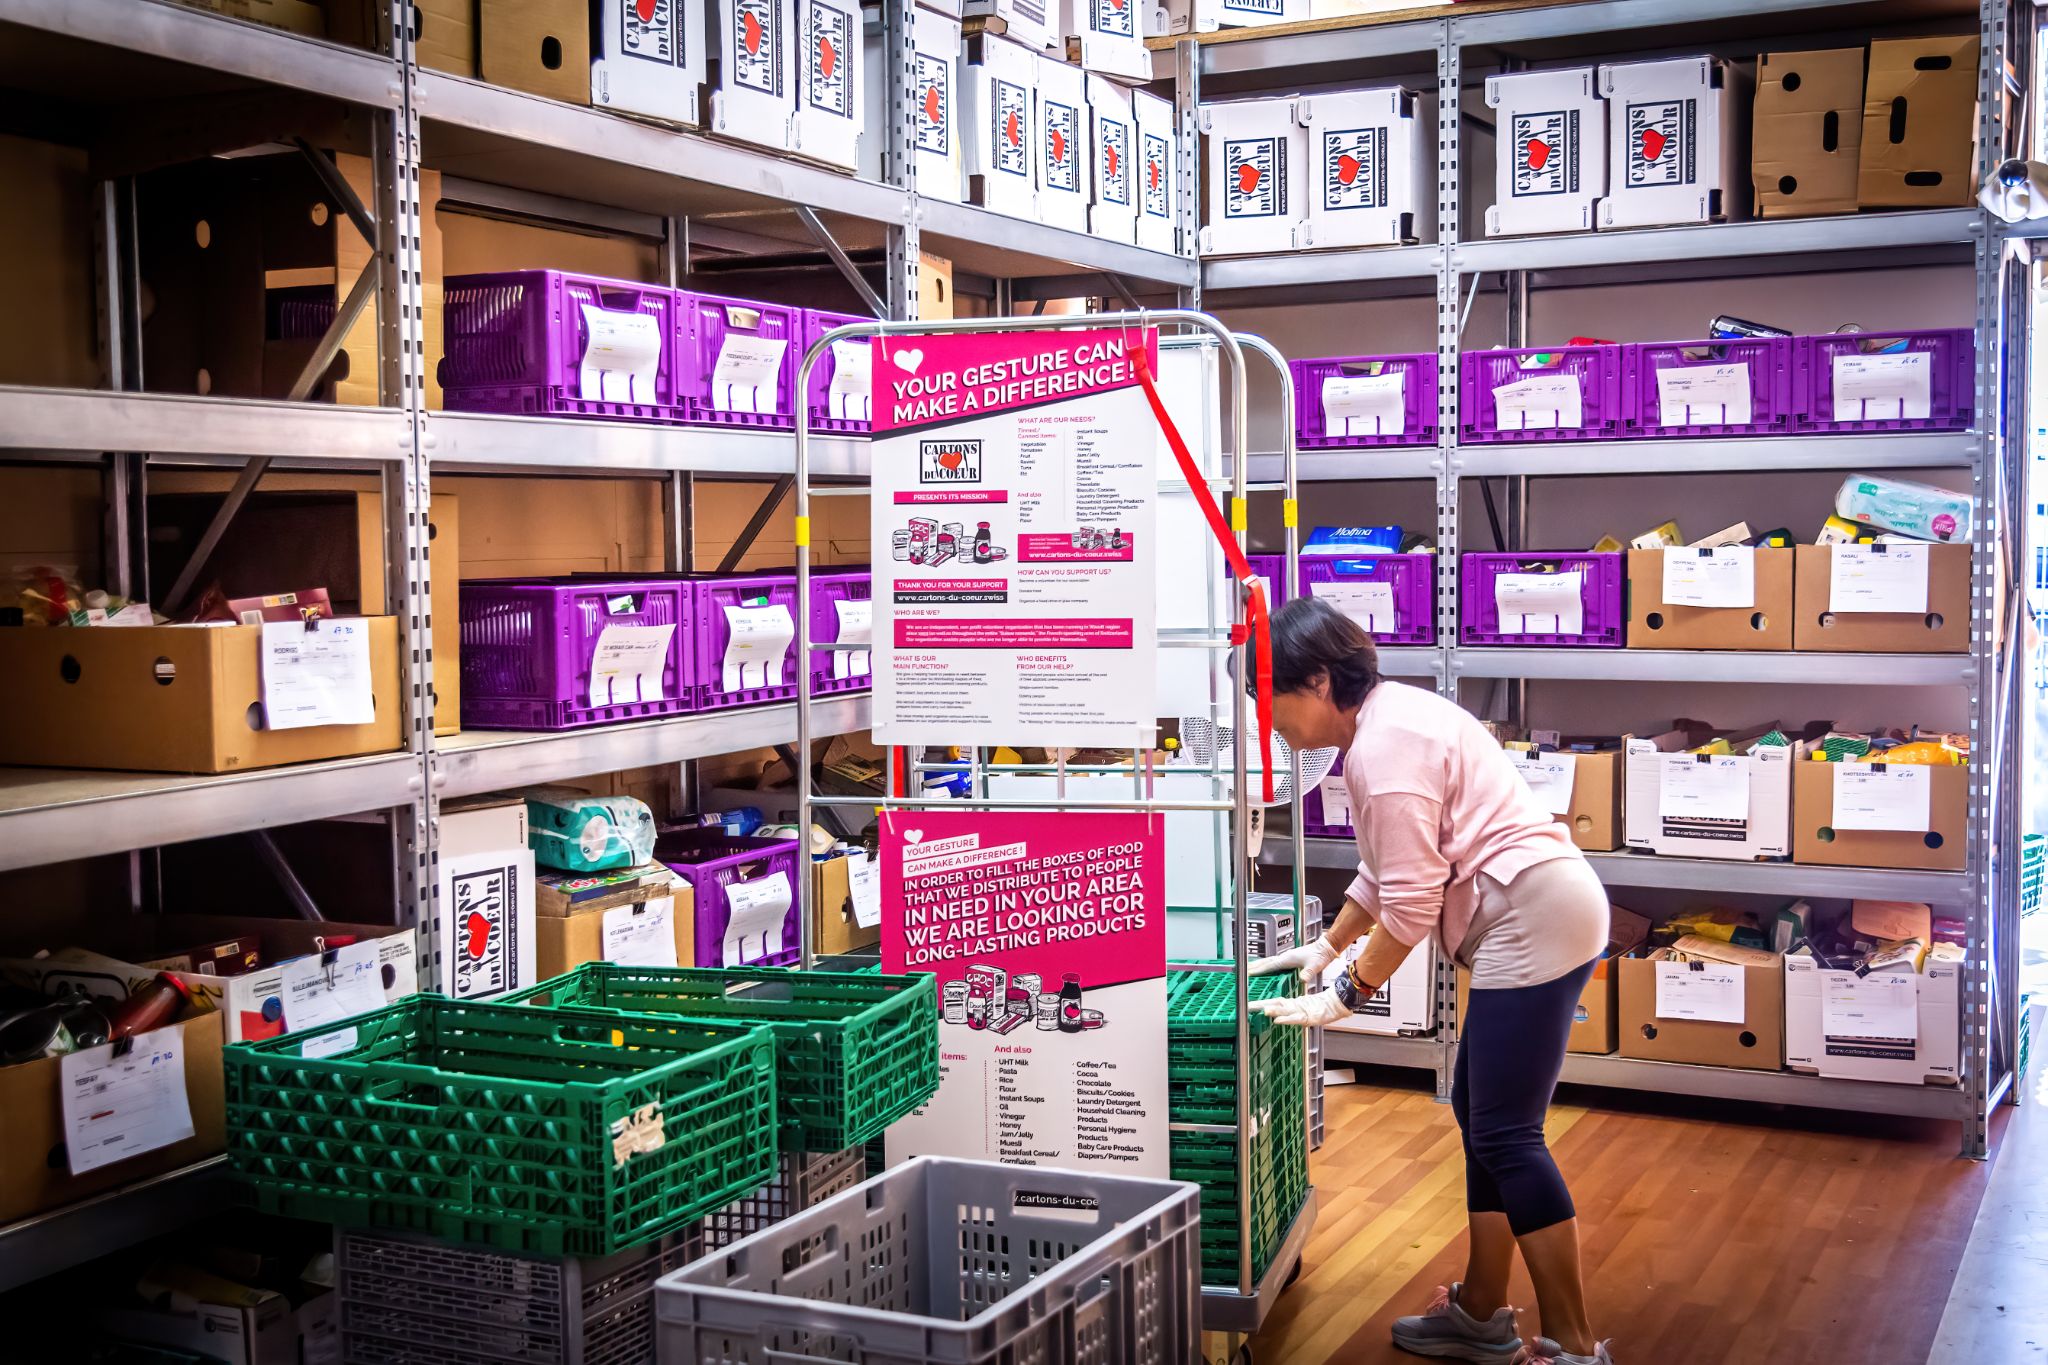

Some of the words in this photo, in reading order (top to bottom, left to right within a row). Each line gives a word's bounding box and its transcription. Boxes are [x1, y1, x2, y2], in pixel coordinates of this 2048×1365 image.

[814, 8, 822, 102] CARTONS
[832, 17, 842, 82] COEUR
[1547, 117, 1562, 169] COEUR
[1632, 110, 1646, 182] CARTONS
[1662, 106, 1678, 159] COEUR
[1257, 144, 1270, 192] COEUR
[1357, 134, 1370, 184] COEUR
[1518, 120, 1530, 190] CARTONS
[1230, 146, 1242, 212] CARTONS
[1329, 136, 1342, 205] CARTONS
[1551, 169, 1562, 188] DU
[1666, 160, 1677, 180] DU
[1261, 192, 1270, 212] DU
[1360, 184, 1370, 202] DU
[892, 372, 956, 400] YOUR
[962, 352, 1068, 386] GESTURE
[1074, 338, 1124, 366] CAN
[892, 396, 958, 424] MAKE
[962, 396, 979, 411] A
[984, 365, 1124, 406] DIFFERENCE
[924, 443, 978, 455] CARTONS
[924, 471, 936, 480] DU
[939, 468, 977, 480] COEUR
[1328, 528, 1372, 537] Molfina
[907, 844, 931, 856] YOUR
[933, 838, 974, 852] GESTURE
[908, 862, 926, 872] CAN
[929, 858, 954, 870] MAKE
[964, 848, 1018, 863] DIFFERENCE
[904, 879, 918, 891] IN
[921, 872, 963, 888] ORDER
[967, 869, 982, 880] TO
[987, 864, 1012, 878] FILL
[1016, 860, 1039, 872] THE
[1044, 852, 1084, 868] BOXES
[1088, 848, 1104, 860] OF
[1108, 841, 1142, 856] FOOD
[906, 890, 942, 906] THAT
[946, 886, 969, 899] WE
[974, 869, 1059, 894] DISTRIBUTE
[1063, 866, 1082, 879] TO
[1086, 856, 1142, 876] PEOPLE
[905, 909, 927, 928] IN
[932, 898, 989, 922] NEED
[995, 893, 1017, 911] IN
[1021, 881, 1081, 908] YOUR
[1086, 872, 1143, 897] AREA
[487, 877, 500, 955] COEUR
[905, 927, 942, 947] WE
[946, 918, 990, 940] ARE
[996, 901, 1095, 932] LOOKING
[1100, 892, 1144, 912] FOR
[458, 882, 472, 993] CARTONS
[906, 929, 1040, 965] LONG-LASTING
[1046, 913, 1145, 942] PRODUCTS
[490, 955, 502, 986] DU
[942, 1052, 968, 1060] items:
[1077, 1088, 1135, 1097] Biscuits/Cookies
[1077, 1098, 1105, 1106] Laundry
[1106, 1099, 1141, 1107] Detergent
[1000, 1113, 1025, 1121] Vinegar
[1000, 1122, 1022, 1130] Honey
[1116, 1108, 1146, 1117] Cleaning
[1000, 1131, 1034, 1140] Jam/Jelly
[1108, 1126, 1136, 1134] Hygiene
[1000, 1148, 1032, 1156] Breakfast
[1034, 1150, 1060, 1158] Cereal/
[1078, 1143, 1094, 1151] Baby
[1113, 1144, 1144, 1152] Products
[1078, 1152, 1139, 1162] Diapers/Pampers
